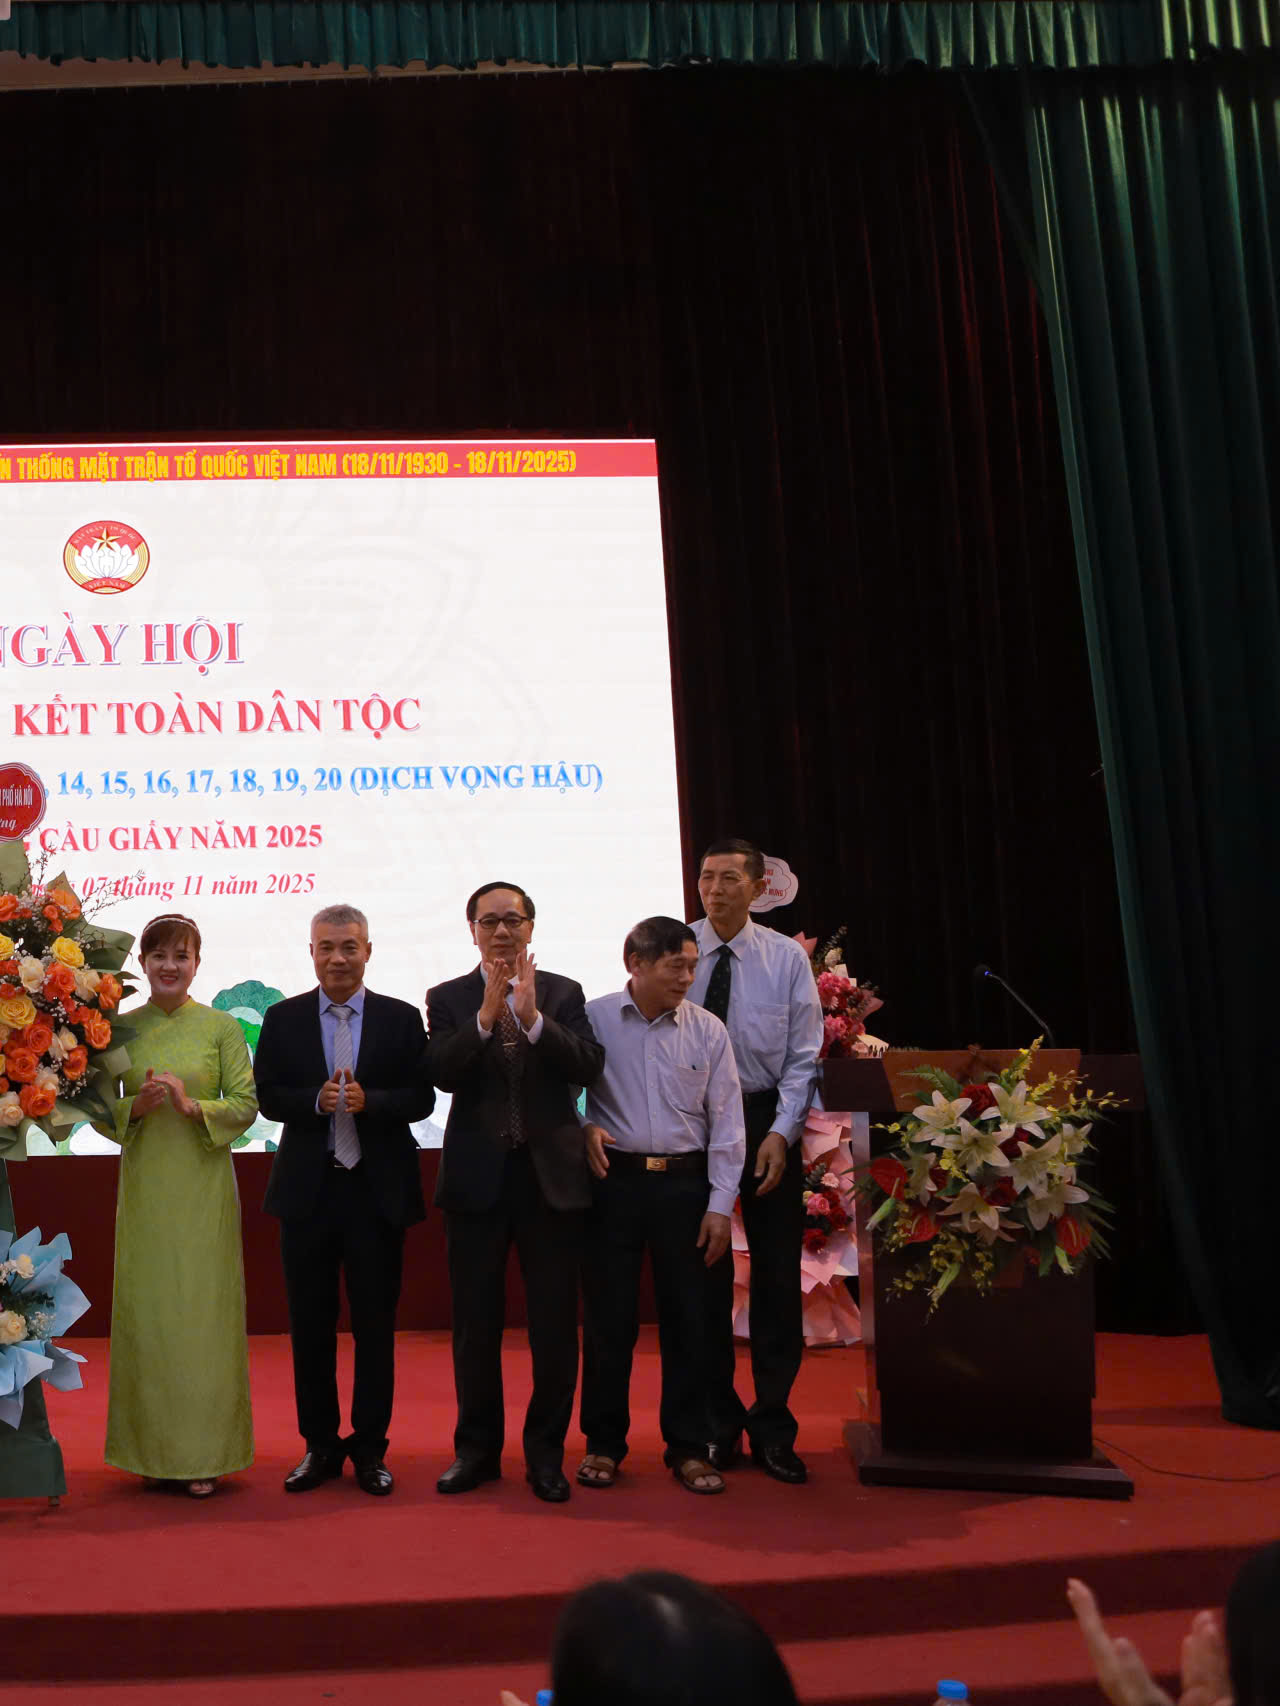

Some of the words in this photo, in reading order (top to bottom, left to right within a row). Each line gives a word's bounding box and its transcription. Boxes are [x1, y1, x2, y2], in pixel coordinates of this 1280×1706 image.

[15, 451, 75, 481] THỐNG
[79, 451, 120, 483] MẶT
[124, 450, 169, 482] TRẬN
[200, 449, 249, 480] QUỐC
[252, 448, 291, 481] VIỆT
[295, 453, 338, 477] NAM
[341, 451, 449, 476] (18/11/1930
[465, 449, 577, 474] 18/11/2025)
[140, 614, 245, 676] HỘI
[13, 693, 99, 737] KẾT
[106, 691, 223, 735] TOÀN
[237, 688, 321, 733] DÂN
[332, 692, 421, 740] TỘC
[3, 783, 15, 807] PHỐ
[15, 785, 23, 806] HÀ
[23, 784, 33, 808] NỘI
[57, 770, 94, 799] 14,
[100, 770, 136, 798] 15,
[143, 769, 180, 796] 16,
[187, 769, 222, 795] 17,
[231, 768, 265, 796] 18,
[273, 767, 308, 793] 19,
[314, 767, 343, 792] 20
[349, 765, 433, 797] (DỊCH
[439, 764, 525, 796] VỌNG
[531, 760, 604, 794] HẬU)
[39, 821, 100, 852] CẦU
[108, 819, 183, 852] GIẤY
[190, 819, 257, 849] NĂM
[265, 823, 323, 849] 2025
[81, 876, 109, 898] 07
[113, 875, 175, 902] tháng
[183, 875, 204, 896] 11
[211, 875, 258, 896] năm
[265, 872, 316, 895] 2025
